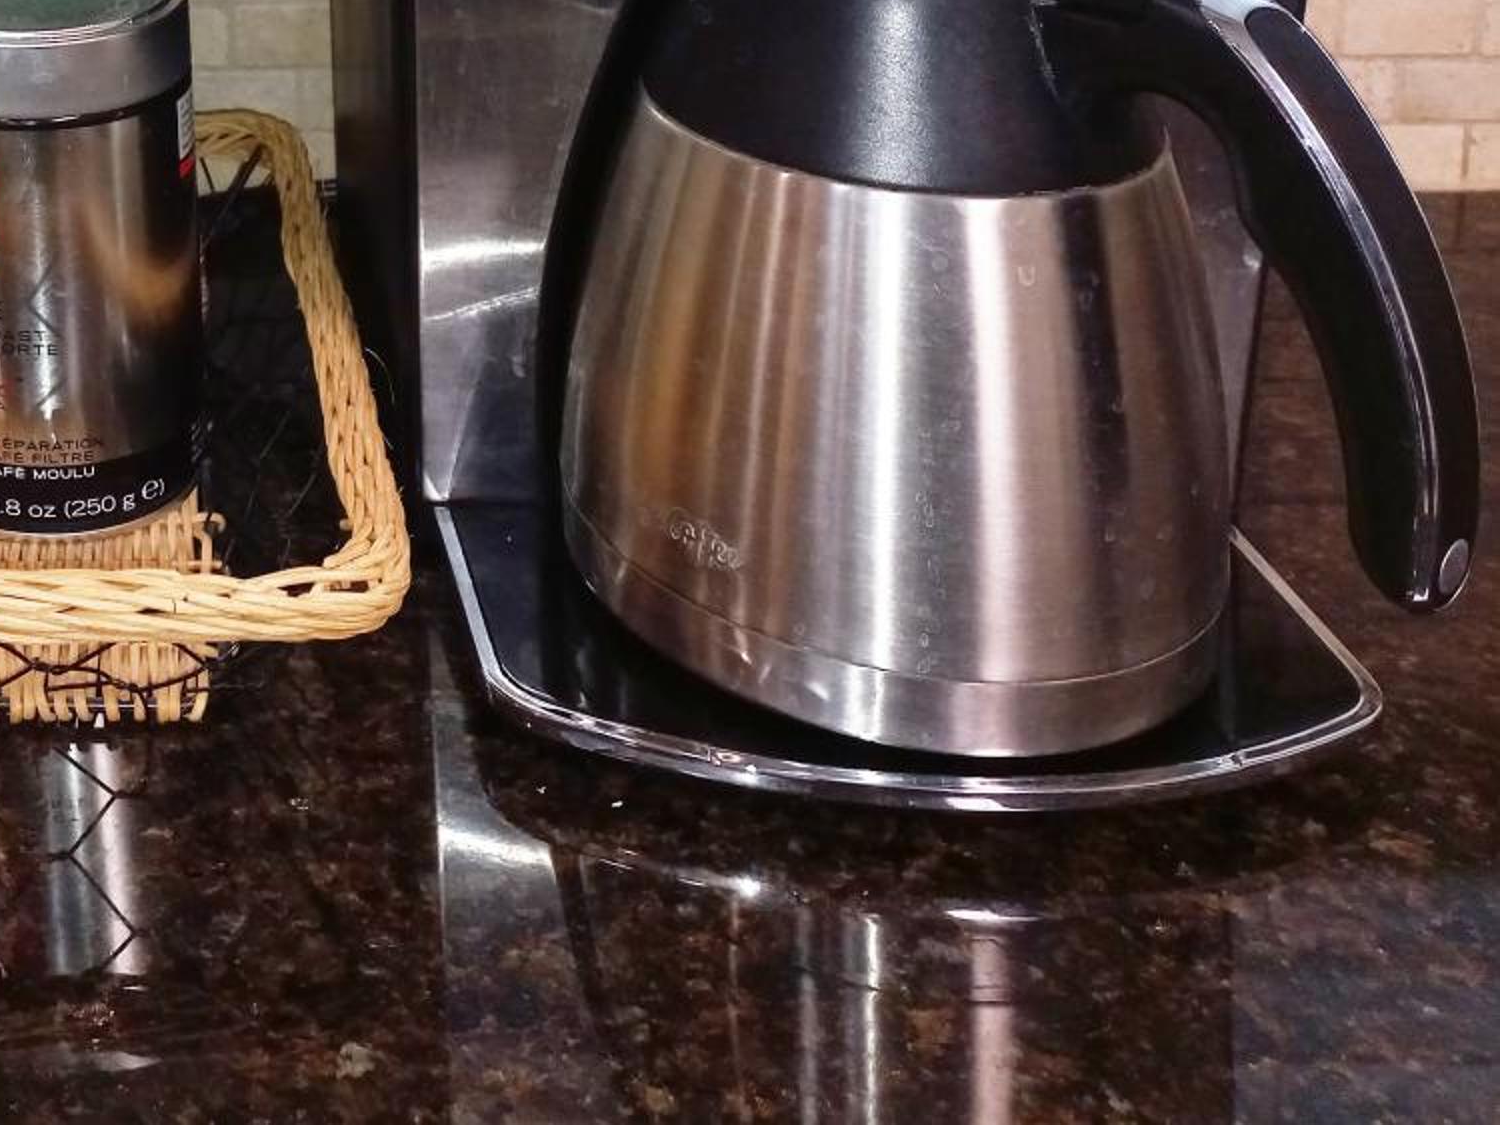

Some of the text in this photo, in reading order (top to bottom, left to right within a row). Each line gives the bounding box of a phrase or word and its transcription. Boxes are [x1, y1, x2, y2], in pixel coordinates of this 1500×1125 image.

[32, 450, 95, 463] FILTRE
[33, 464, 95, 481] MOULU
[28, 504, 56, 518] oz
[64, 495, 116, 518] (250
[122, 492, 136, 511] g
